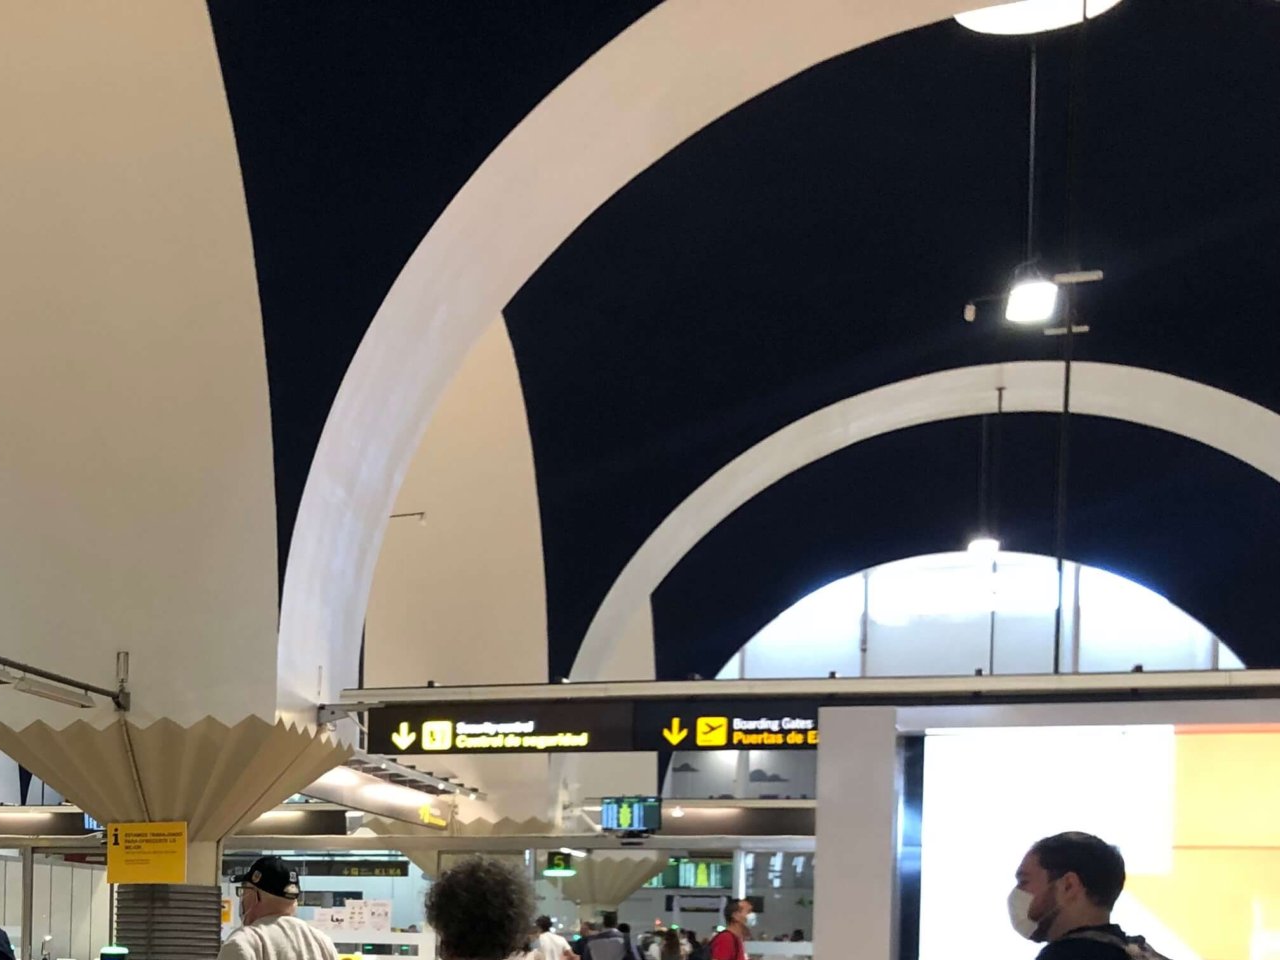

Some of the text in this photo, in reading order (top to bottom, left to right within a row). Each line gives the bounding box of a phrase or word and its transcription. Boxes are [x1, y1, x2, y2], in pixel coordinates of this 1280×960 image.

[732, 717, 814, 731] Boarding Gates
[732, 730, 818, 745] Puertas de E
